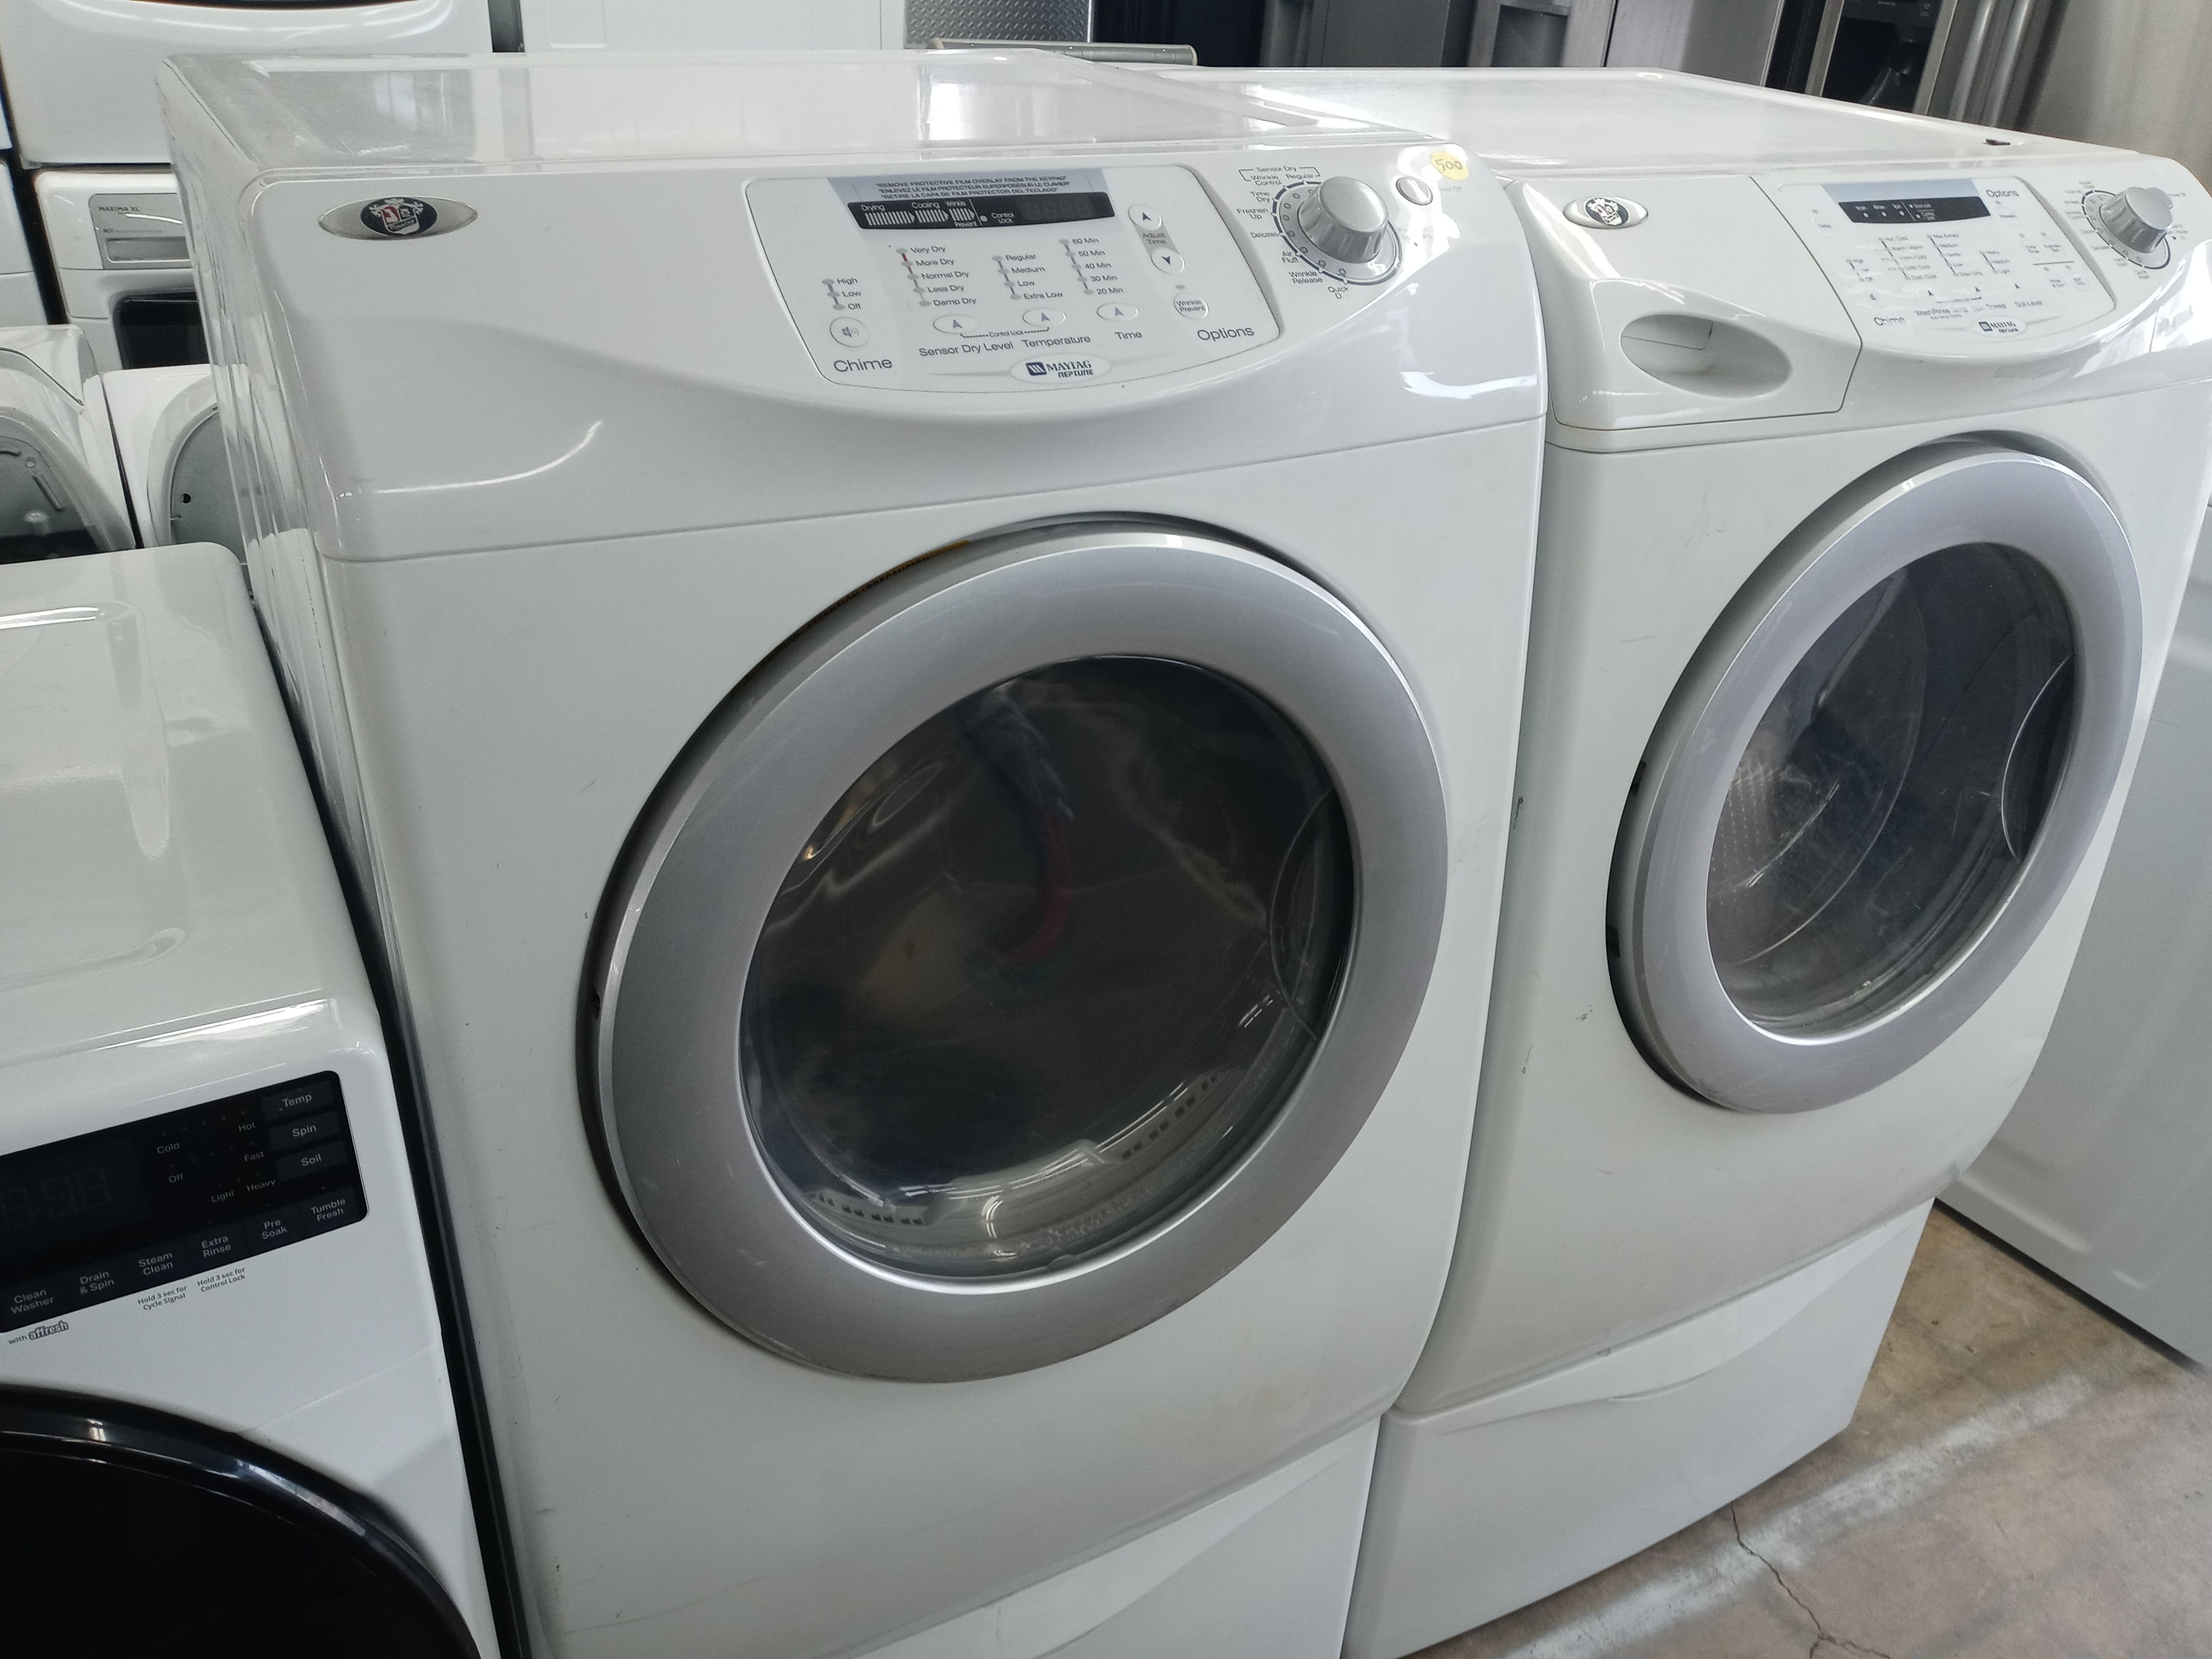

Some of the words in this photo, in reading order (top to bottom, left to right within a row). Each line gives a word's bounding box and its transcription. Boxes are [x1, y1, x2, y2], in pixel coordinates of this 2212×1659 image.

[1435, 158, 1463, 171] 500
[1986, 189, 2020, 198] Options
[933, 298, 960, 307] Damp
[1874, 317, 1906, 326] Chime
[1022, 336, 1091, 347] Temperature
[1115, 331, 1142, 340] Time
[1197, 327, 1254, 342] Options
[919, 347, 958, 357] Sensor
[961, 344, 981, 354] Dry
[984, 340, 1014, 351] Level
[834, 358, 893, 372] Chime
[1046, 359, 1092, 372] MAYTAG
[282, 1094, 312, 1108] Temp
[238, 1121, 256, 1132] Hot
[292, 1124, 317, 1137] Spin
[157, 1142, 180, 1154] Cold
[244, 1151, 265, 1162] Fast
[301, 1154, 322, 1166] Soil
[169, 1173, 184, 1184] Off
[211, 1190, 235, 1203] Light
[247, 1179, 276, 1192] Heavy
[310, 1197, 346, 1214] Tumble
[317, 1208, 344, 1222] Fresh
[264, 1219, 281, 1230] Pre
[261, 1226, 288, 1239] Soak
[201, 1235, 229, 1250] Extra
[203, 1244, 232, 1258] Rinse
[138, 1252, 173, 1268] Steam
[143, 1261, 173, 1276] Clean
[79, 1271, 110, 1285] Drain
[197, 1277, 214, 1287] Hold
[221, 1270, 233, 1279] sec
[200, 1279, 227, 1293] Control
[229, 1273, 246, 1284] Lock
[90, 1279, 115, 1292] Spin
[14, 1289, 47, 1304] Clean
[138, 1295, 155, 1305] Hold
[163, 1289, 175, 1297] sec
[143, 1300, 163, 1311] Cycle
[163, 1293, 186, 1306] Signal
[11, 1296, 54, 1314] Washer
[9, 1335, 28, 1345] with
[29, 1320, 69, 1340] affresh
